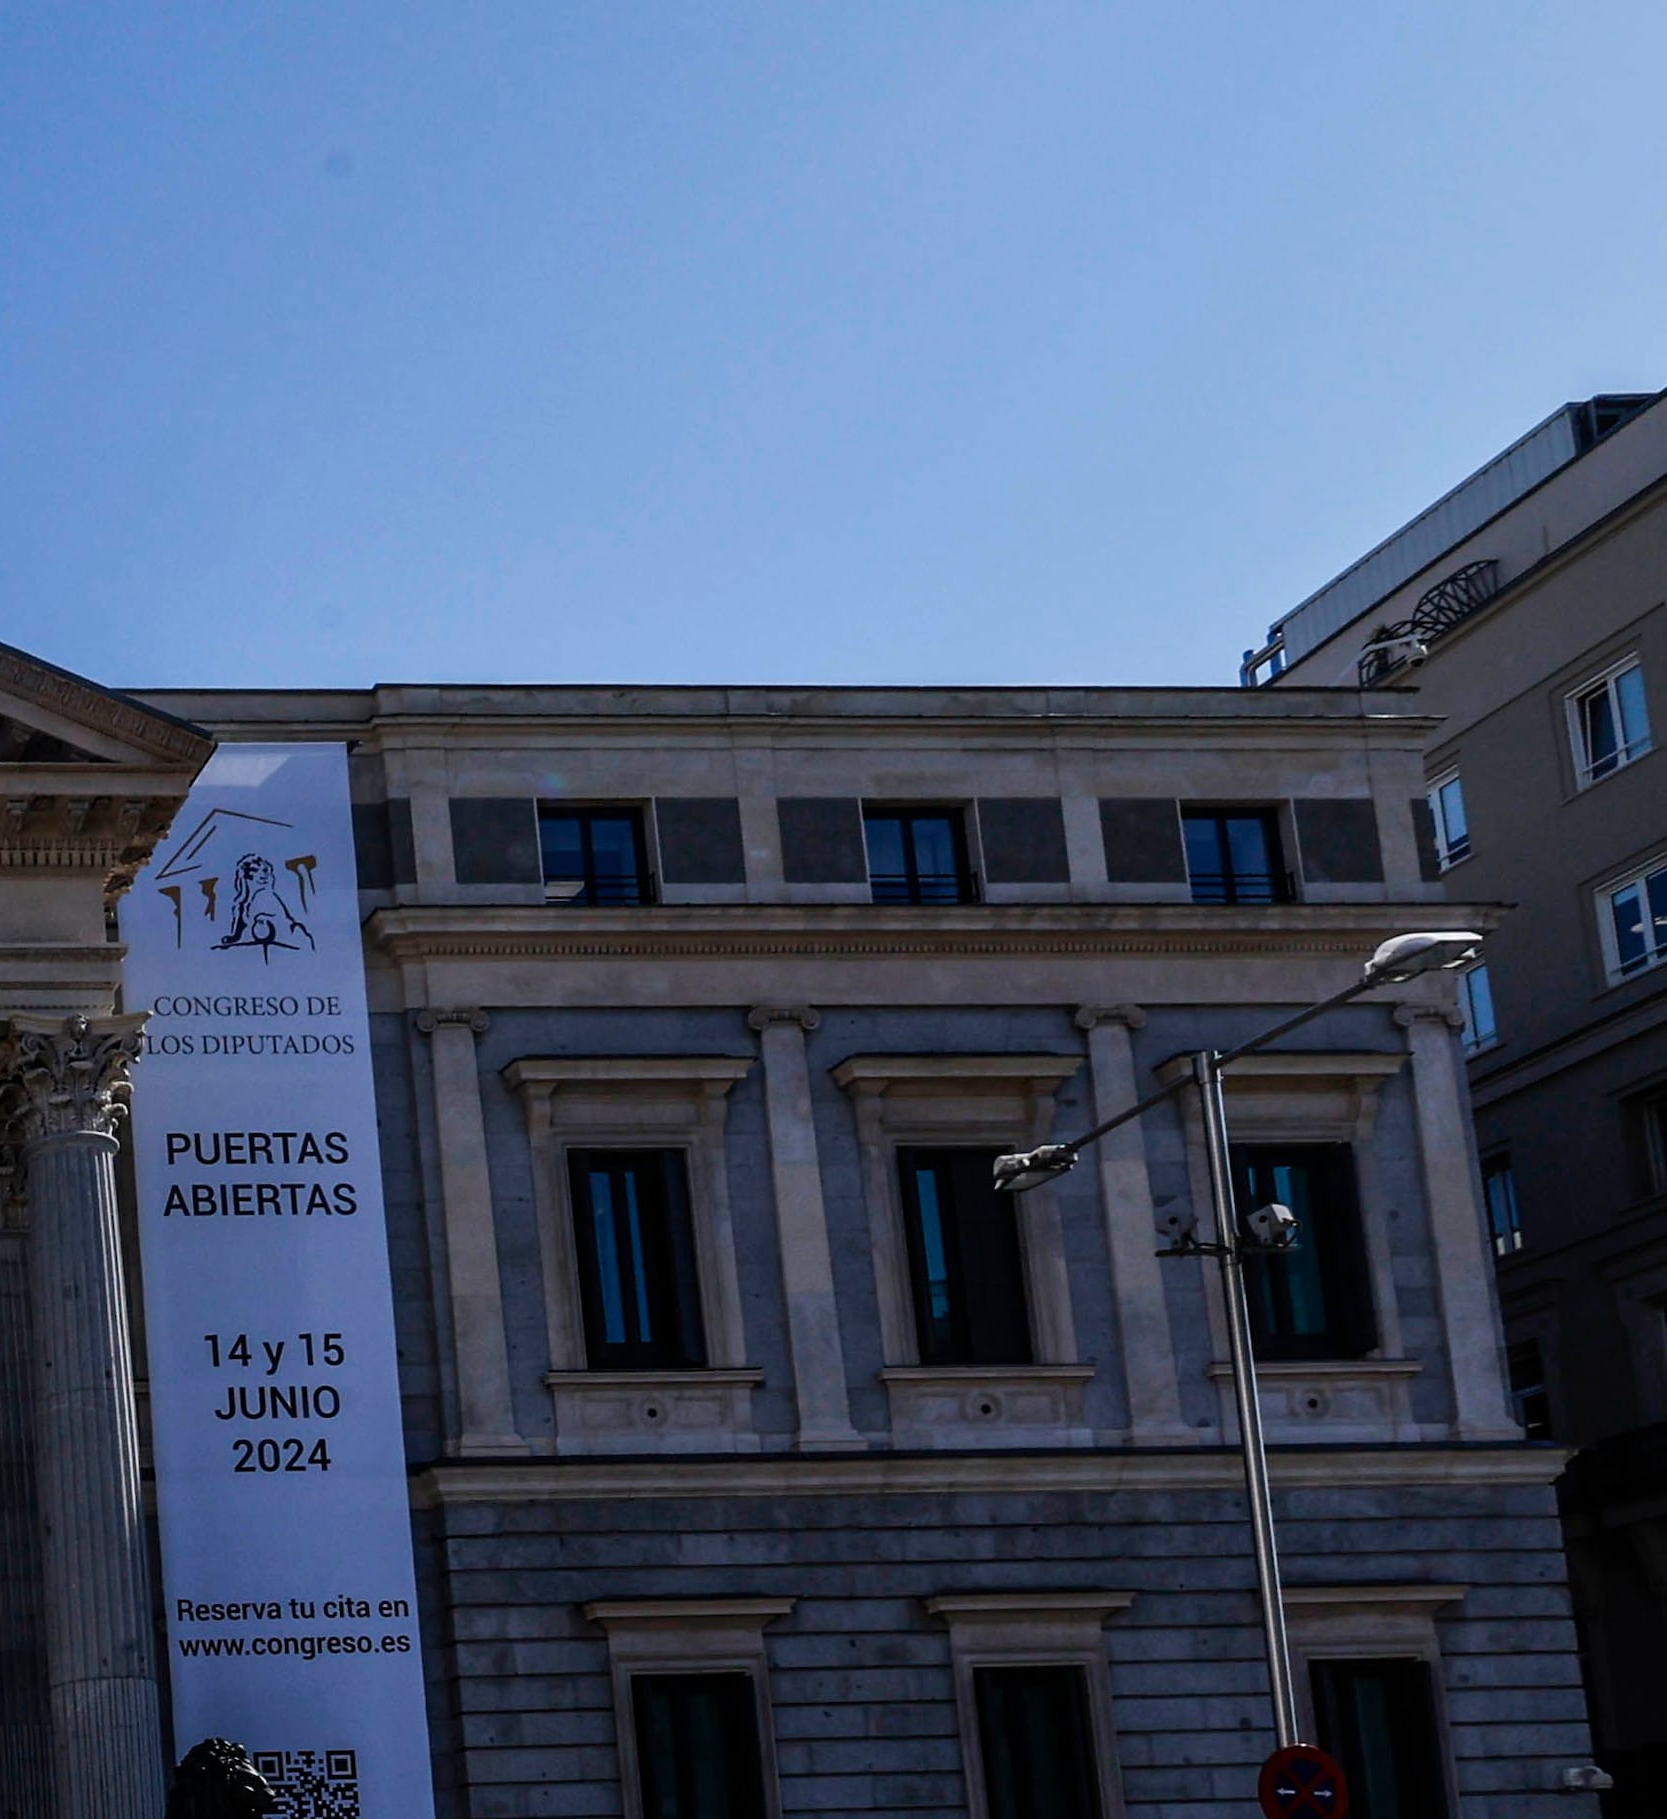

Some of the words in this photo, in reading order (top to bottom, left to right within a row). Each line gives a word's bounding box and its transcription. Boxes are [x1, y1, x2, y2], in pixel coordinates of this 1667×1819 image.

[153, 996, 299, 1017] CONGRESO
[306, 996, 342, 1016] DE
[146, 1035, 195, 1055] LOS
[201, 1034, 355, 1055] DIPUTADOS
[166, 1131, 349, 1166] PUERTAS
[163, 1183, 357, 1217] ABIERTAS
[204, 1334, 252, 1368] 14
[262, 1341, 285, 1376] y
[298, 1333, 345, 1366] 15
[214, 1385, 340, 1420] JUNIO
[232, 1438, 332, 1473] 2024
[177, 1599, 282, 1622] Reserva
[288, 1598, 316, 1620] tu
[323, 1594, 371, 1619] cita
[378, 1600, 409, 1618] en
[178, 1635, 411, 1661] www.congreso.es
